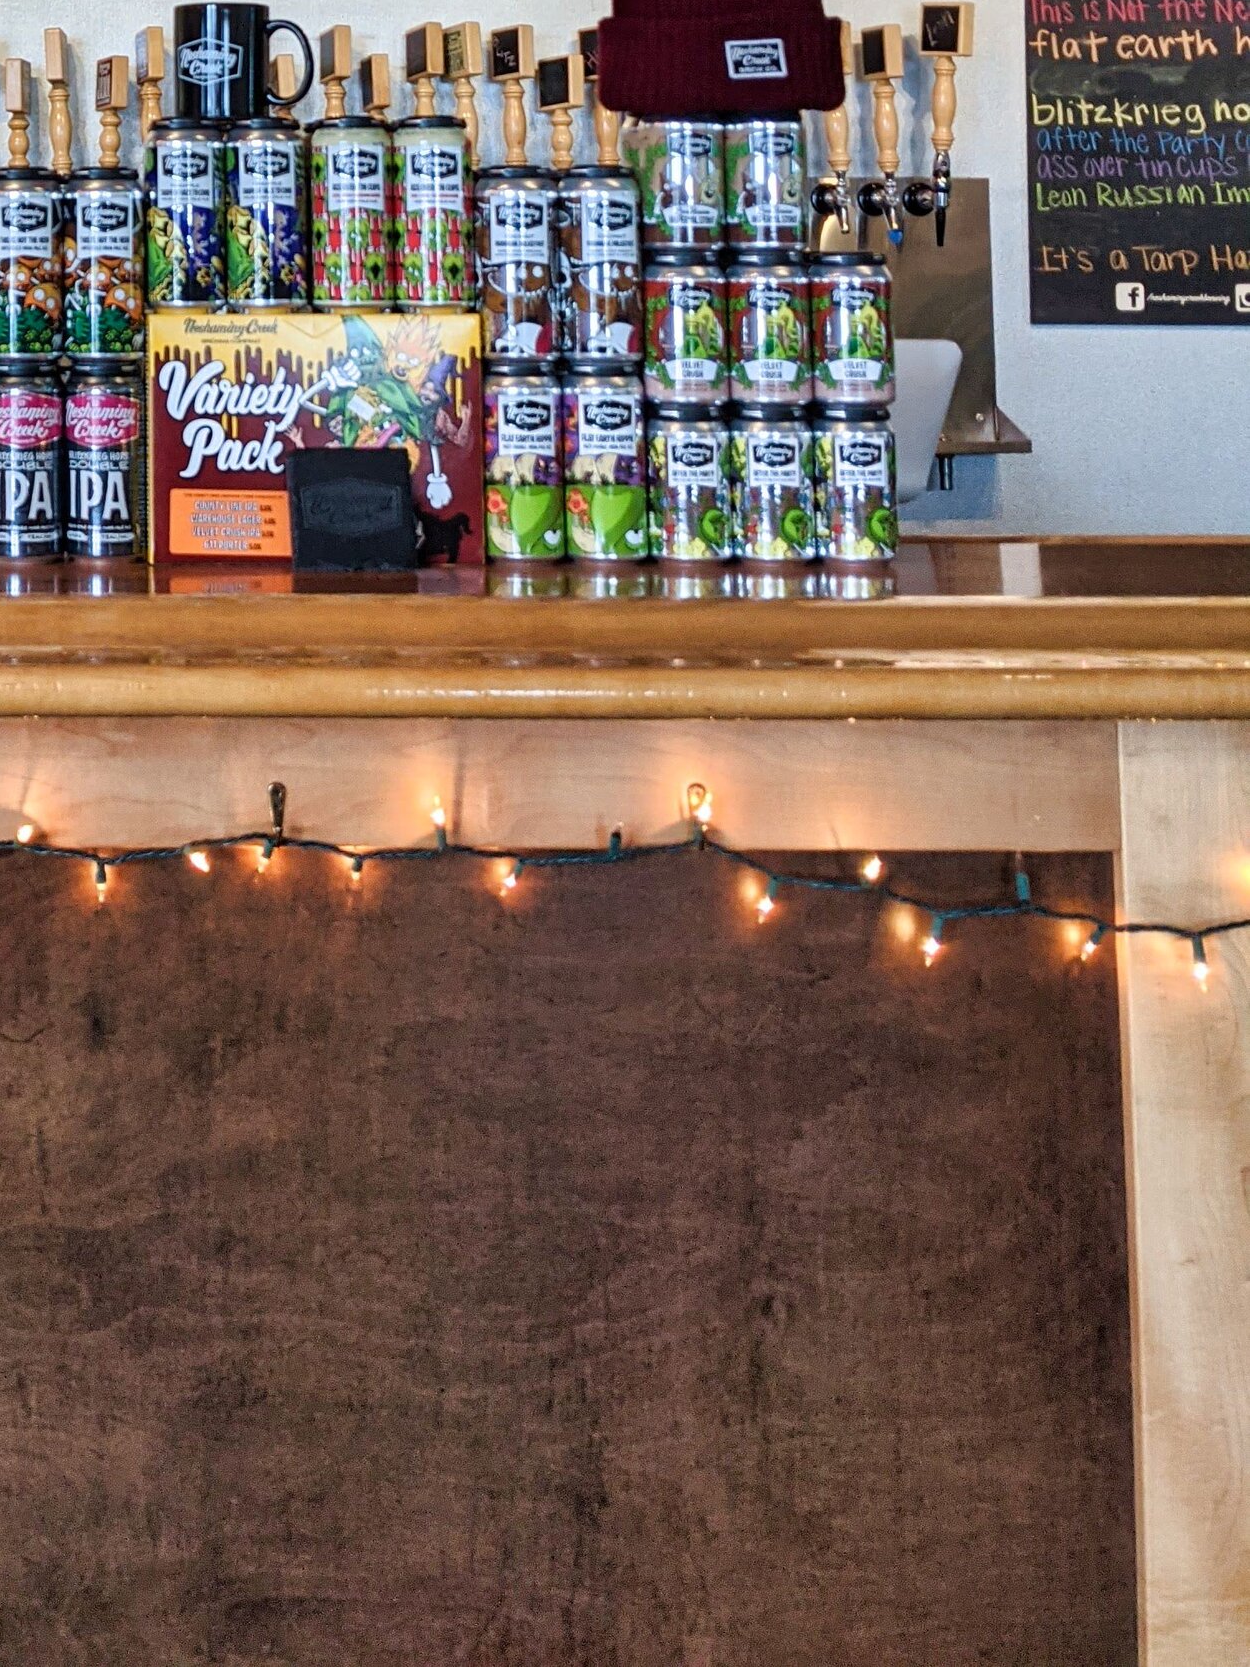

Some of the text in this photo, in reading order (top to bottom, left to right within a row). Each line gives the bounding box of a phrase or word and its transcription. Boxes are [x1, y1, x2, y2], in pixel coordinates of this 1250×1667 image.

[1028, 29, 1218, 63] flat earth
[1037, 127, 1103, 153] after
[1109, 127, 1150, 155] the
[1156, 132, 1226, 162] Party
[1084, 155, 1173, 180] over tin
[1132, 245, 1199, 275] Tarp
[159, 359, 304, 433] Variety
[179, 418, 285, 478] Pack
[70, 470, 129, 520] IPA
